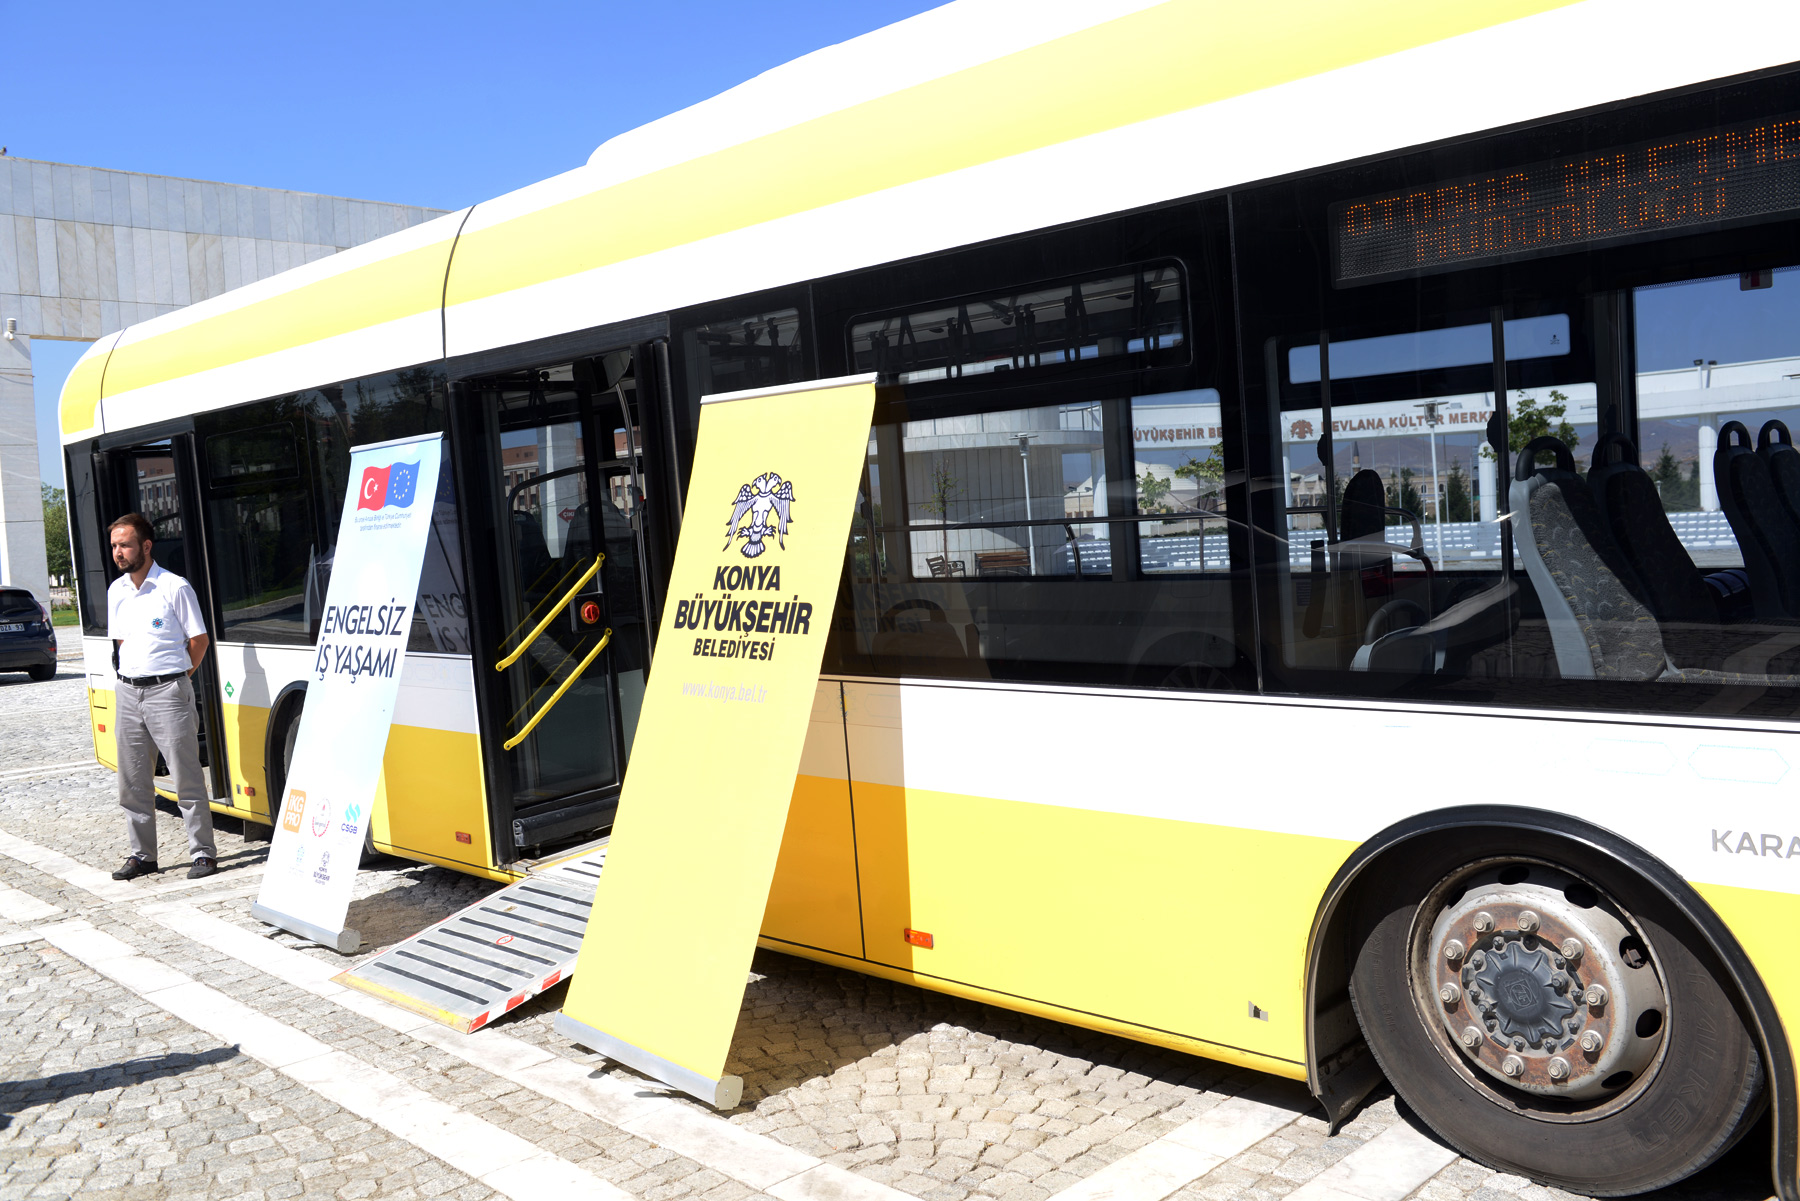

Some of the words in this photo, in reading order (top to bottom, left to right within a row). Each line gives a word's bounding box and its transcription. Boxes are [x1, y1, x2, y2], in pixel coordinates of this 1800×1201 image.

[1321, 417, 1385, 432] EVLANA
[1389, 413, 1445, 428] KÜLTR
[713, 565, 780, 591] KONYA
[323, 597, 407, 636] ENGELSİZ
[674, 593, 813, 638] BÜYÜKŞEHİR
[315, 636, 331, 681] İŞ
[334, 644, 398, 684] YAŞAMI
[693, 636, 776, 661] BELEDİYESİ
[682, 680, 768, 704] www.konya.bel.tr
[284, 811, 301, 827] PRO
[1711, 828, 1800, 859] KARA
